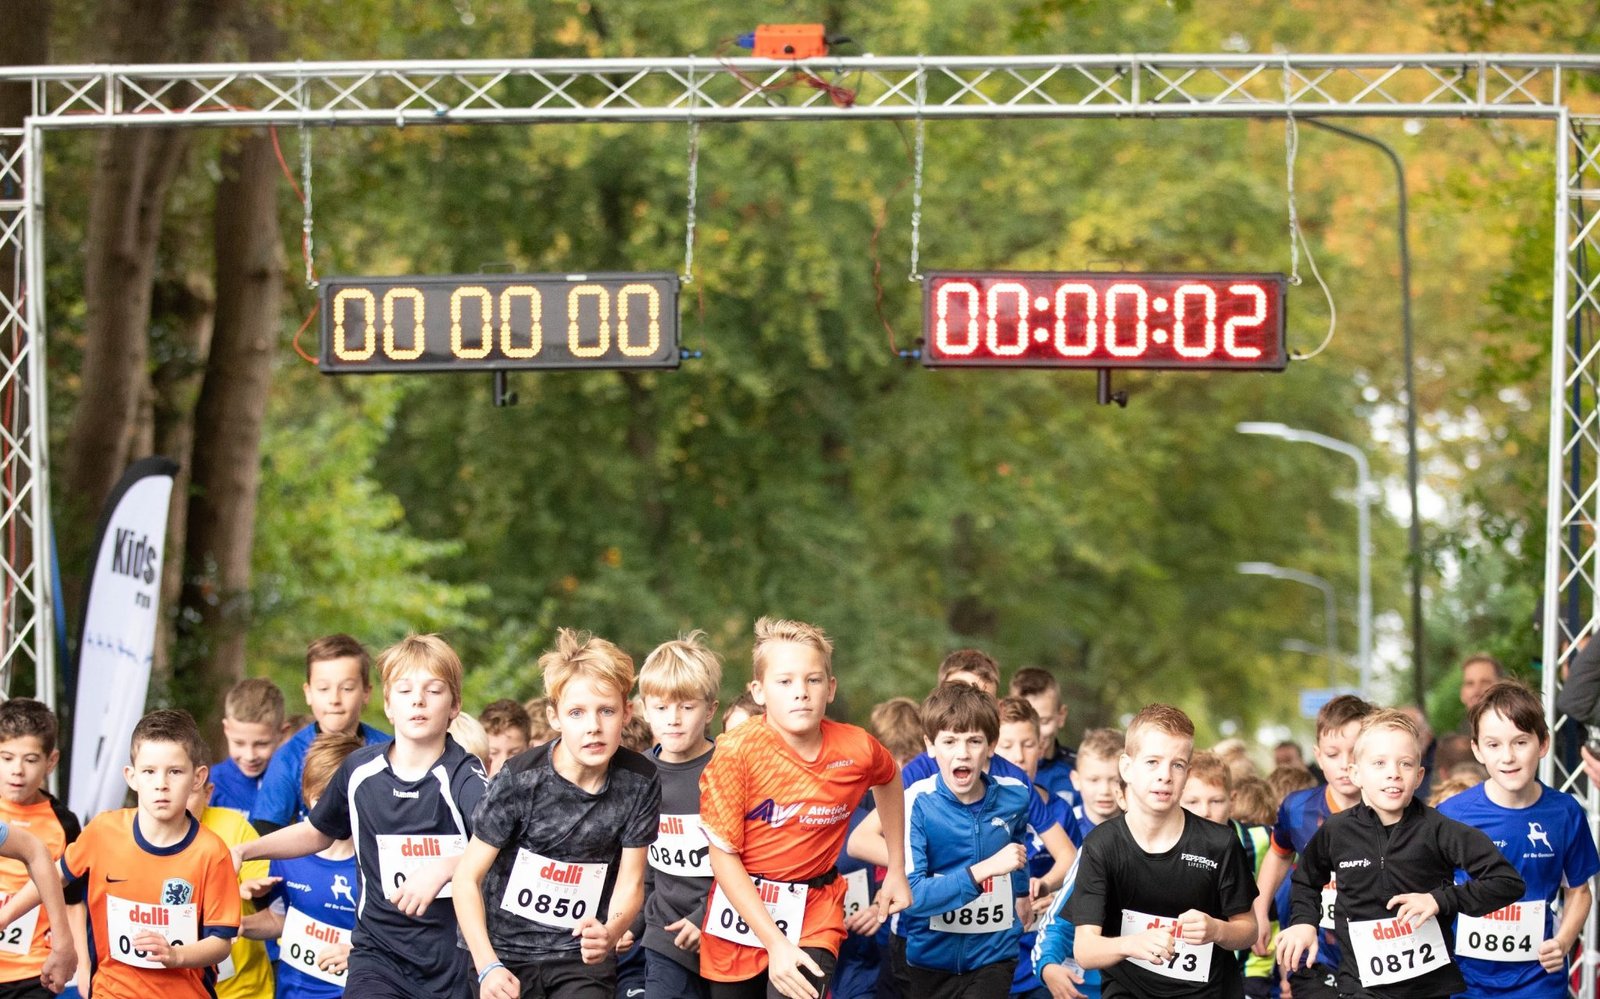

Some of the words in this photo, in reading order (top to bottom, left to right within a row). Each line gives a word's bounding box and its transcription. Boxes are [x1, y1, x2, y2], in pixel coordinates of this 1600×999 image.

[334, 288, 425, 361] 00
[450, 286, 542, 359] 00
[567, 284, 660, 358] 00
[936, 282, 1267, 357] 00:00:02
[112, 527, 157, 585] Kids
[393, 788, 419, 799] hummel
[807, 803, 848, 816] Atletiek
[658, 817, 684, 835] alli
[401, 837, 441, 857] dalli
[650, 844, 702, 868] 0840
[540, 862, 583, 885] dalli
[1339, 860, 1364, 869] CRAFT
[129, 904, 169, 926] dalli
[518, 888, 586, 920] 0850
[942, 904, 1004, 926] 0855
[305, 922, 341, 945] dalli
[1468, 931, 1532, 953] 0864
[1370, 943, 1435, 976] 0872
